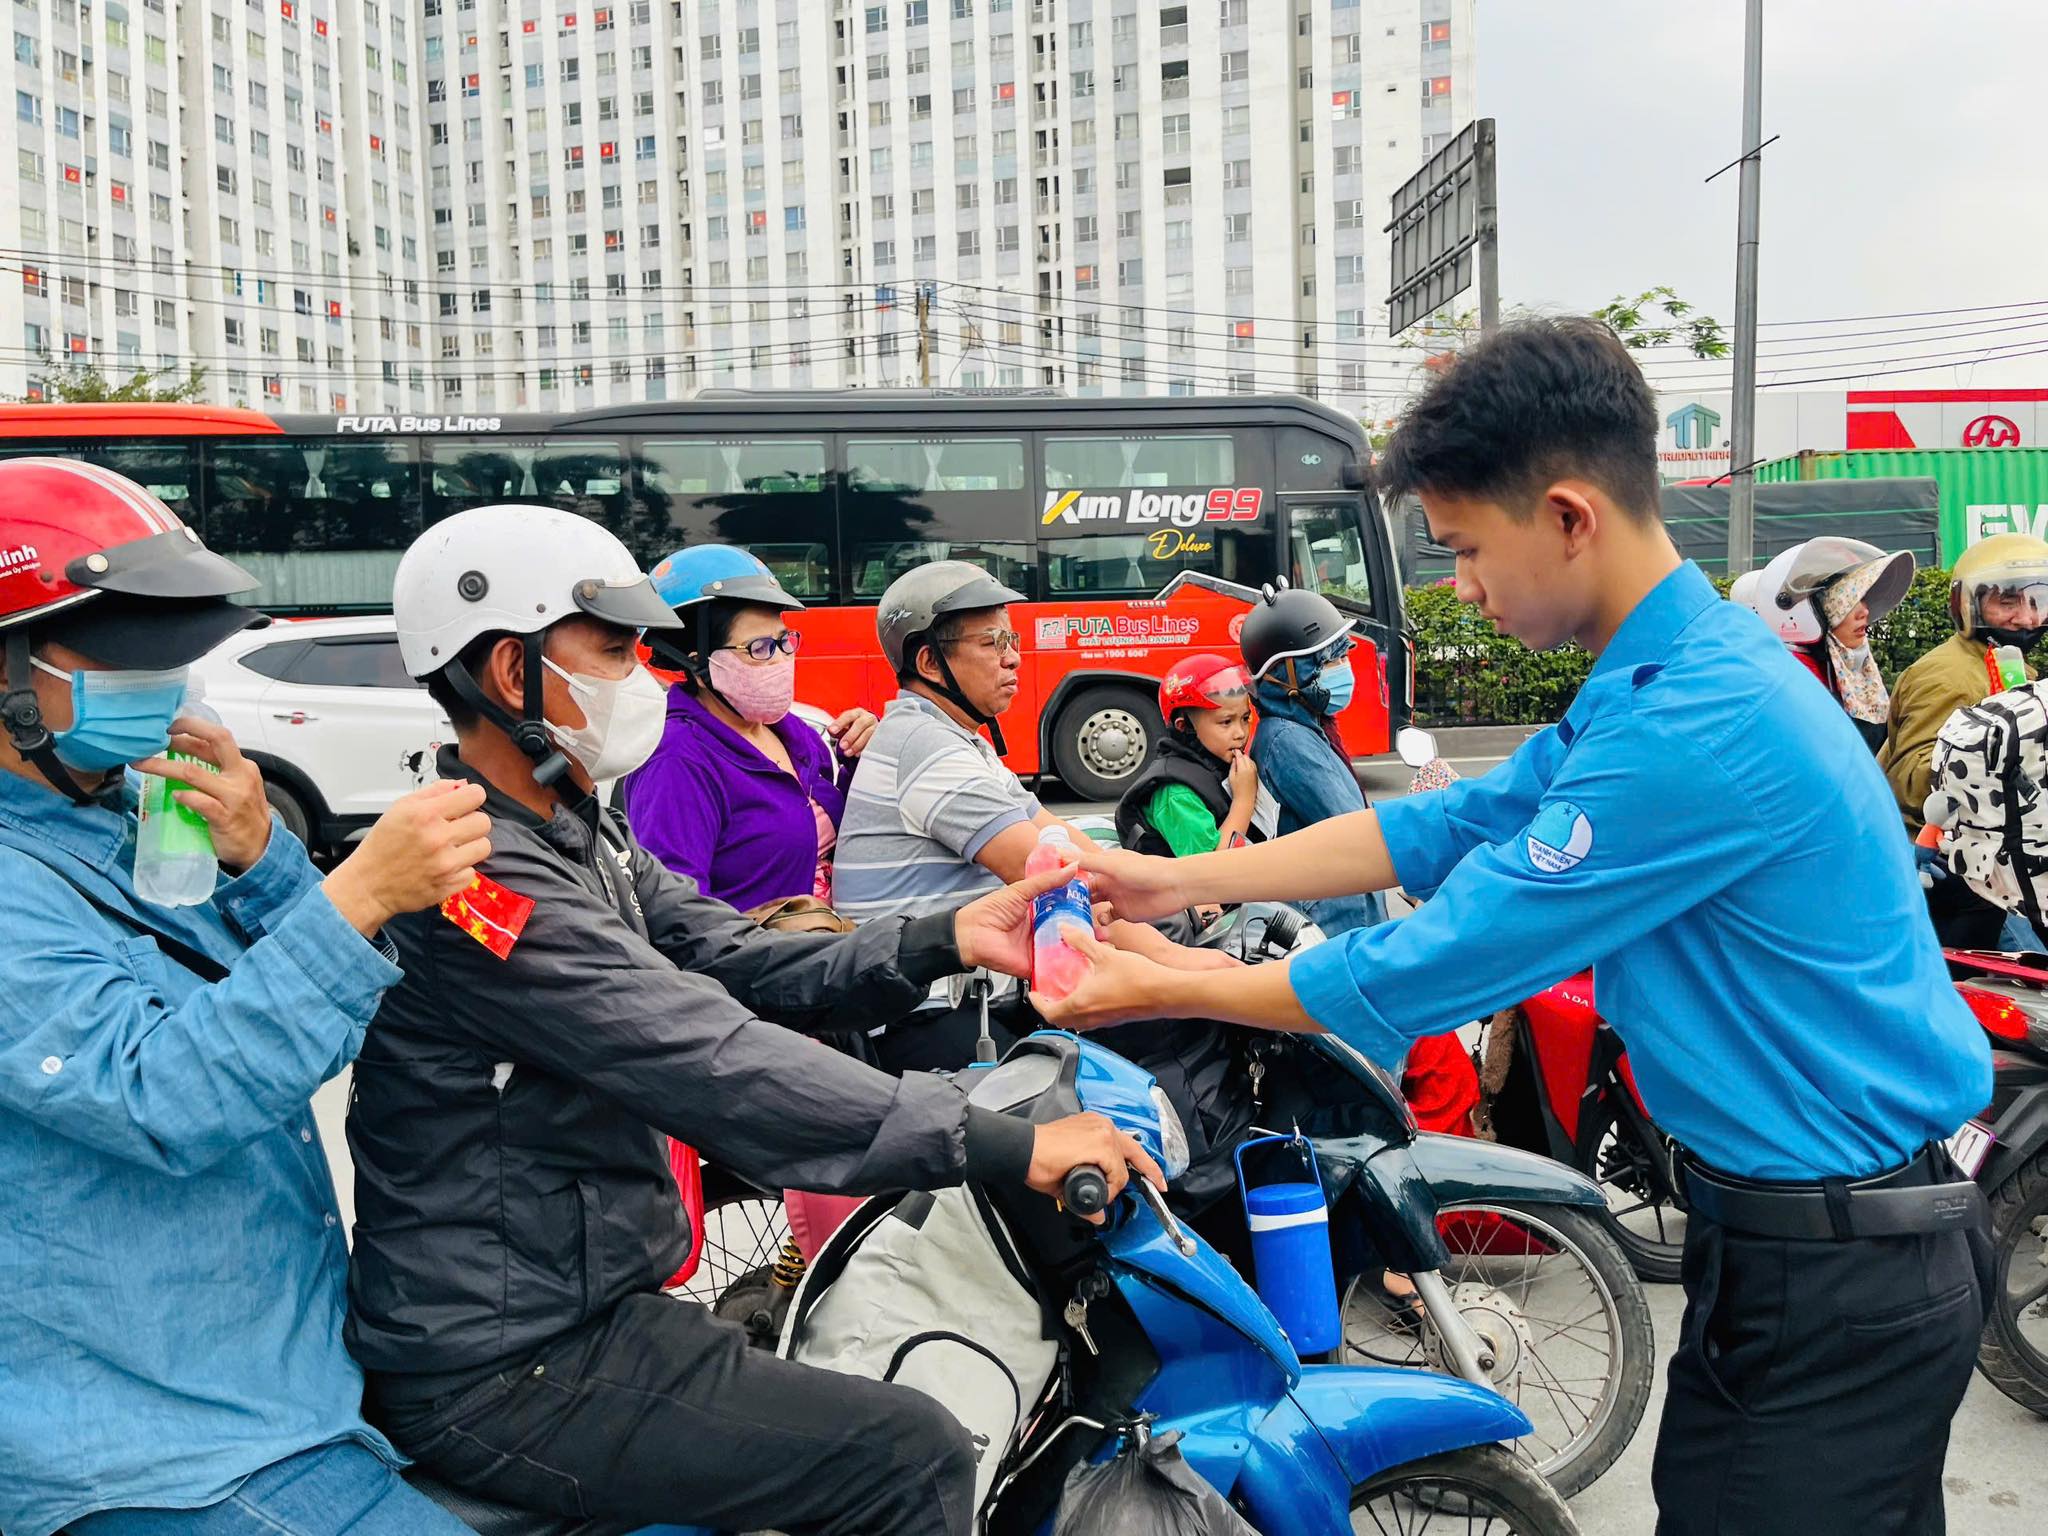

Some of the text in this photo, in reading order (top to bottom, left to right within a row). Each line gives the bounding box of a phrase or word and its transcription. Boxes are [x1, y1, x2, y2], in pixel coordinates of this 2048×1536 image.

[337, 416, 501, 433] FUTA Bus Lines
[1041, 490, 1122, 524] Kim
[1148, 528, 1212, 560] Deluxe
[0, 545, 38, 568] inh
[1066, 617, 1113, 636] FUTA
[1115, 617, 1150, 635] Bus
[1151, 615, 1199, 634] Lines
